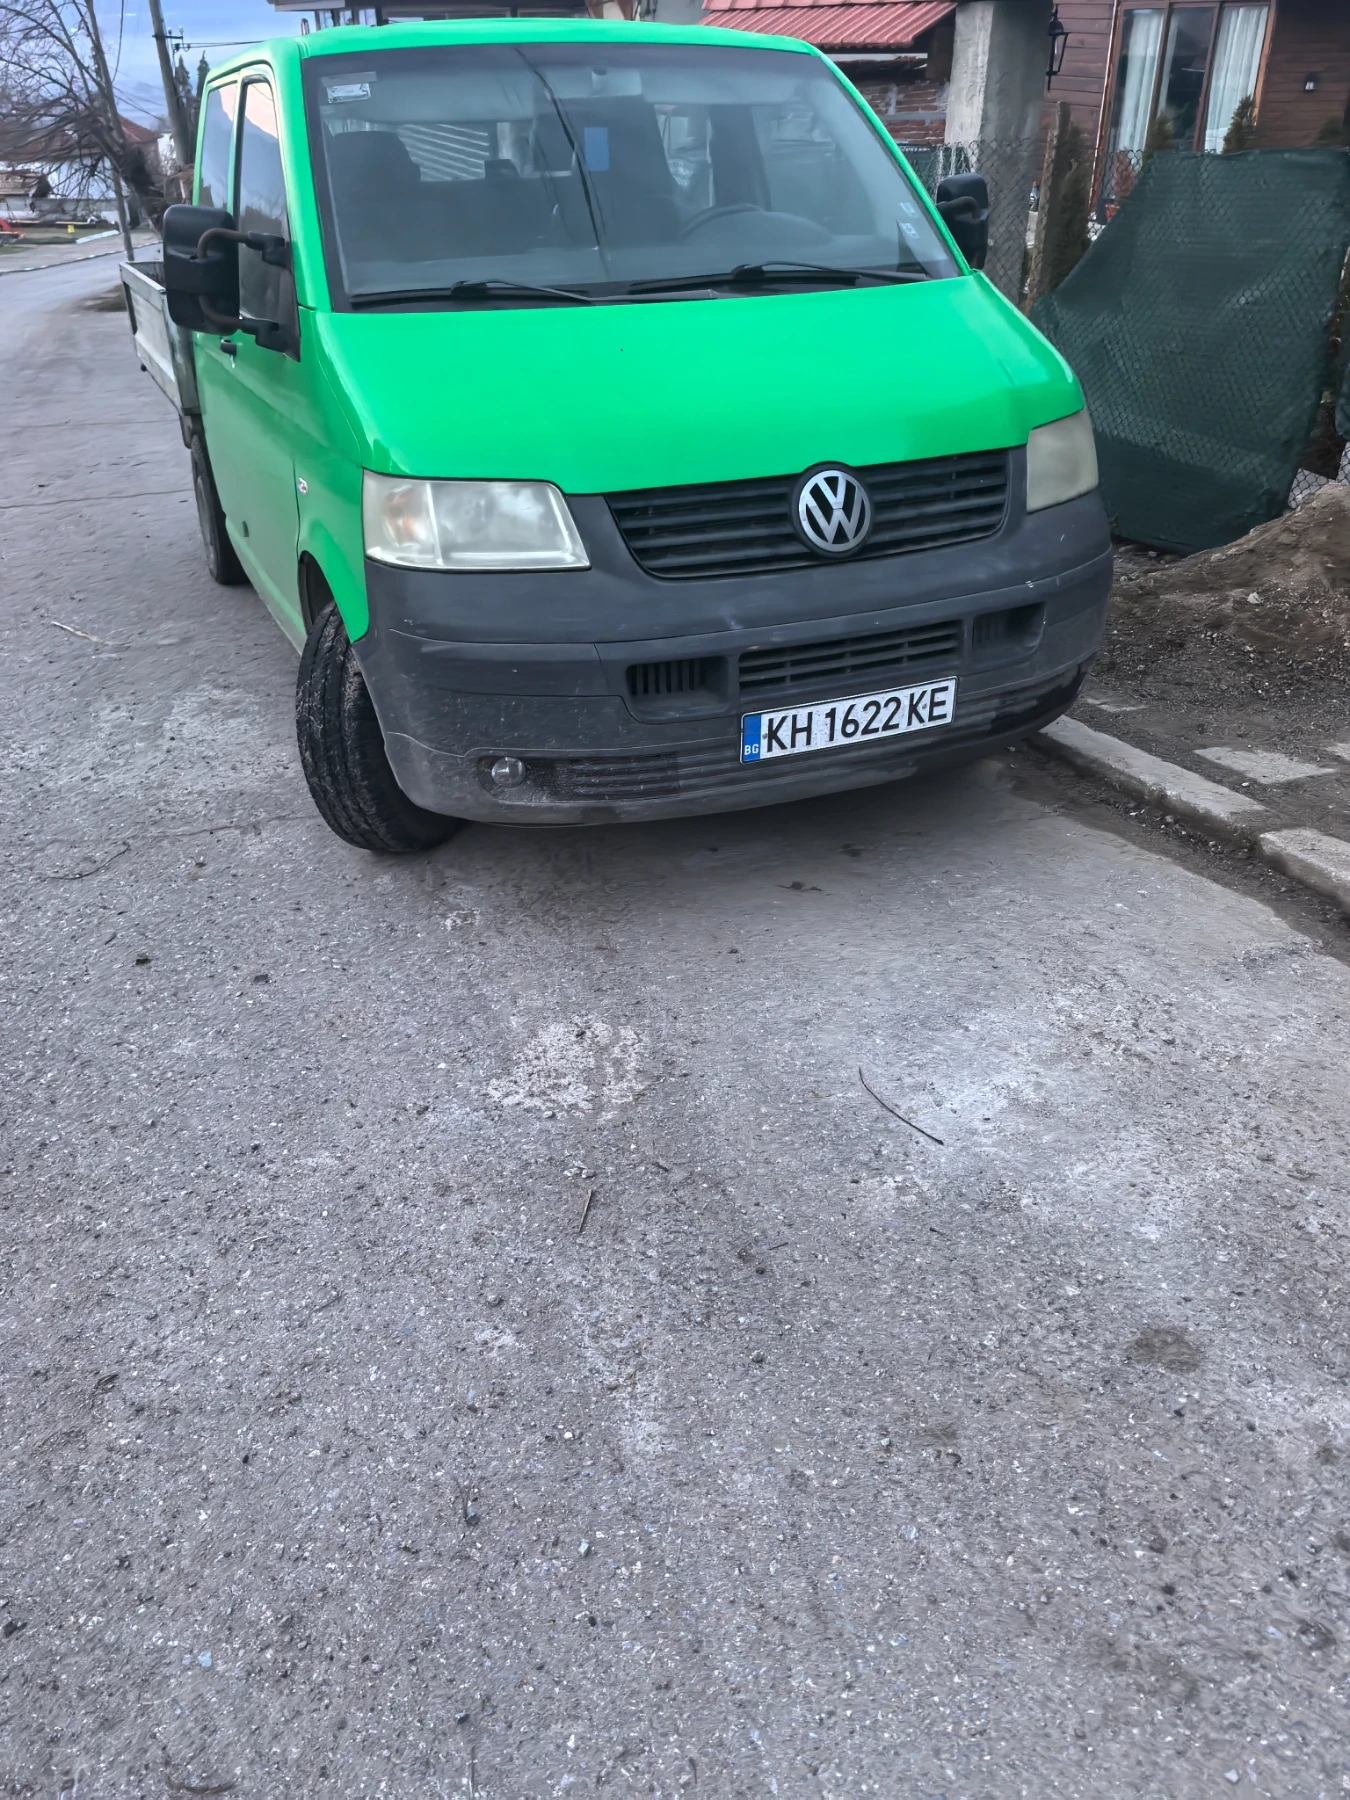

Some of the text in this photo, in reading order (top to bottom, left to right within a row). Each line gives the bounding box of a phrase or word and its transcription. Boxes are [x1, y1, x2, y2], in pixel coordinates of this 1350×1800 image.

[799, 470, 871, 552] VW
[744, 743, 759, 755] BG
[766, 686, 949, 753] KH 1622 KE
